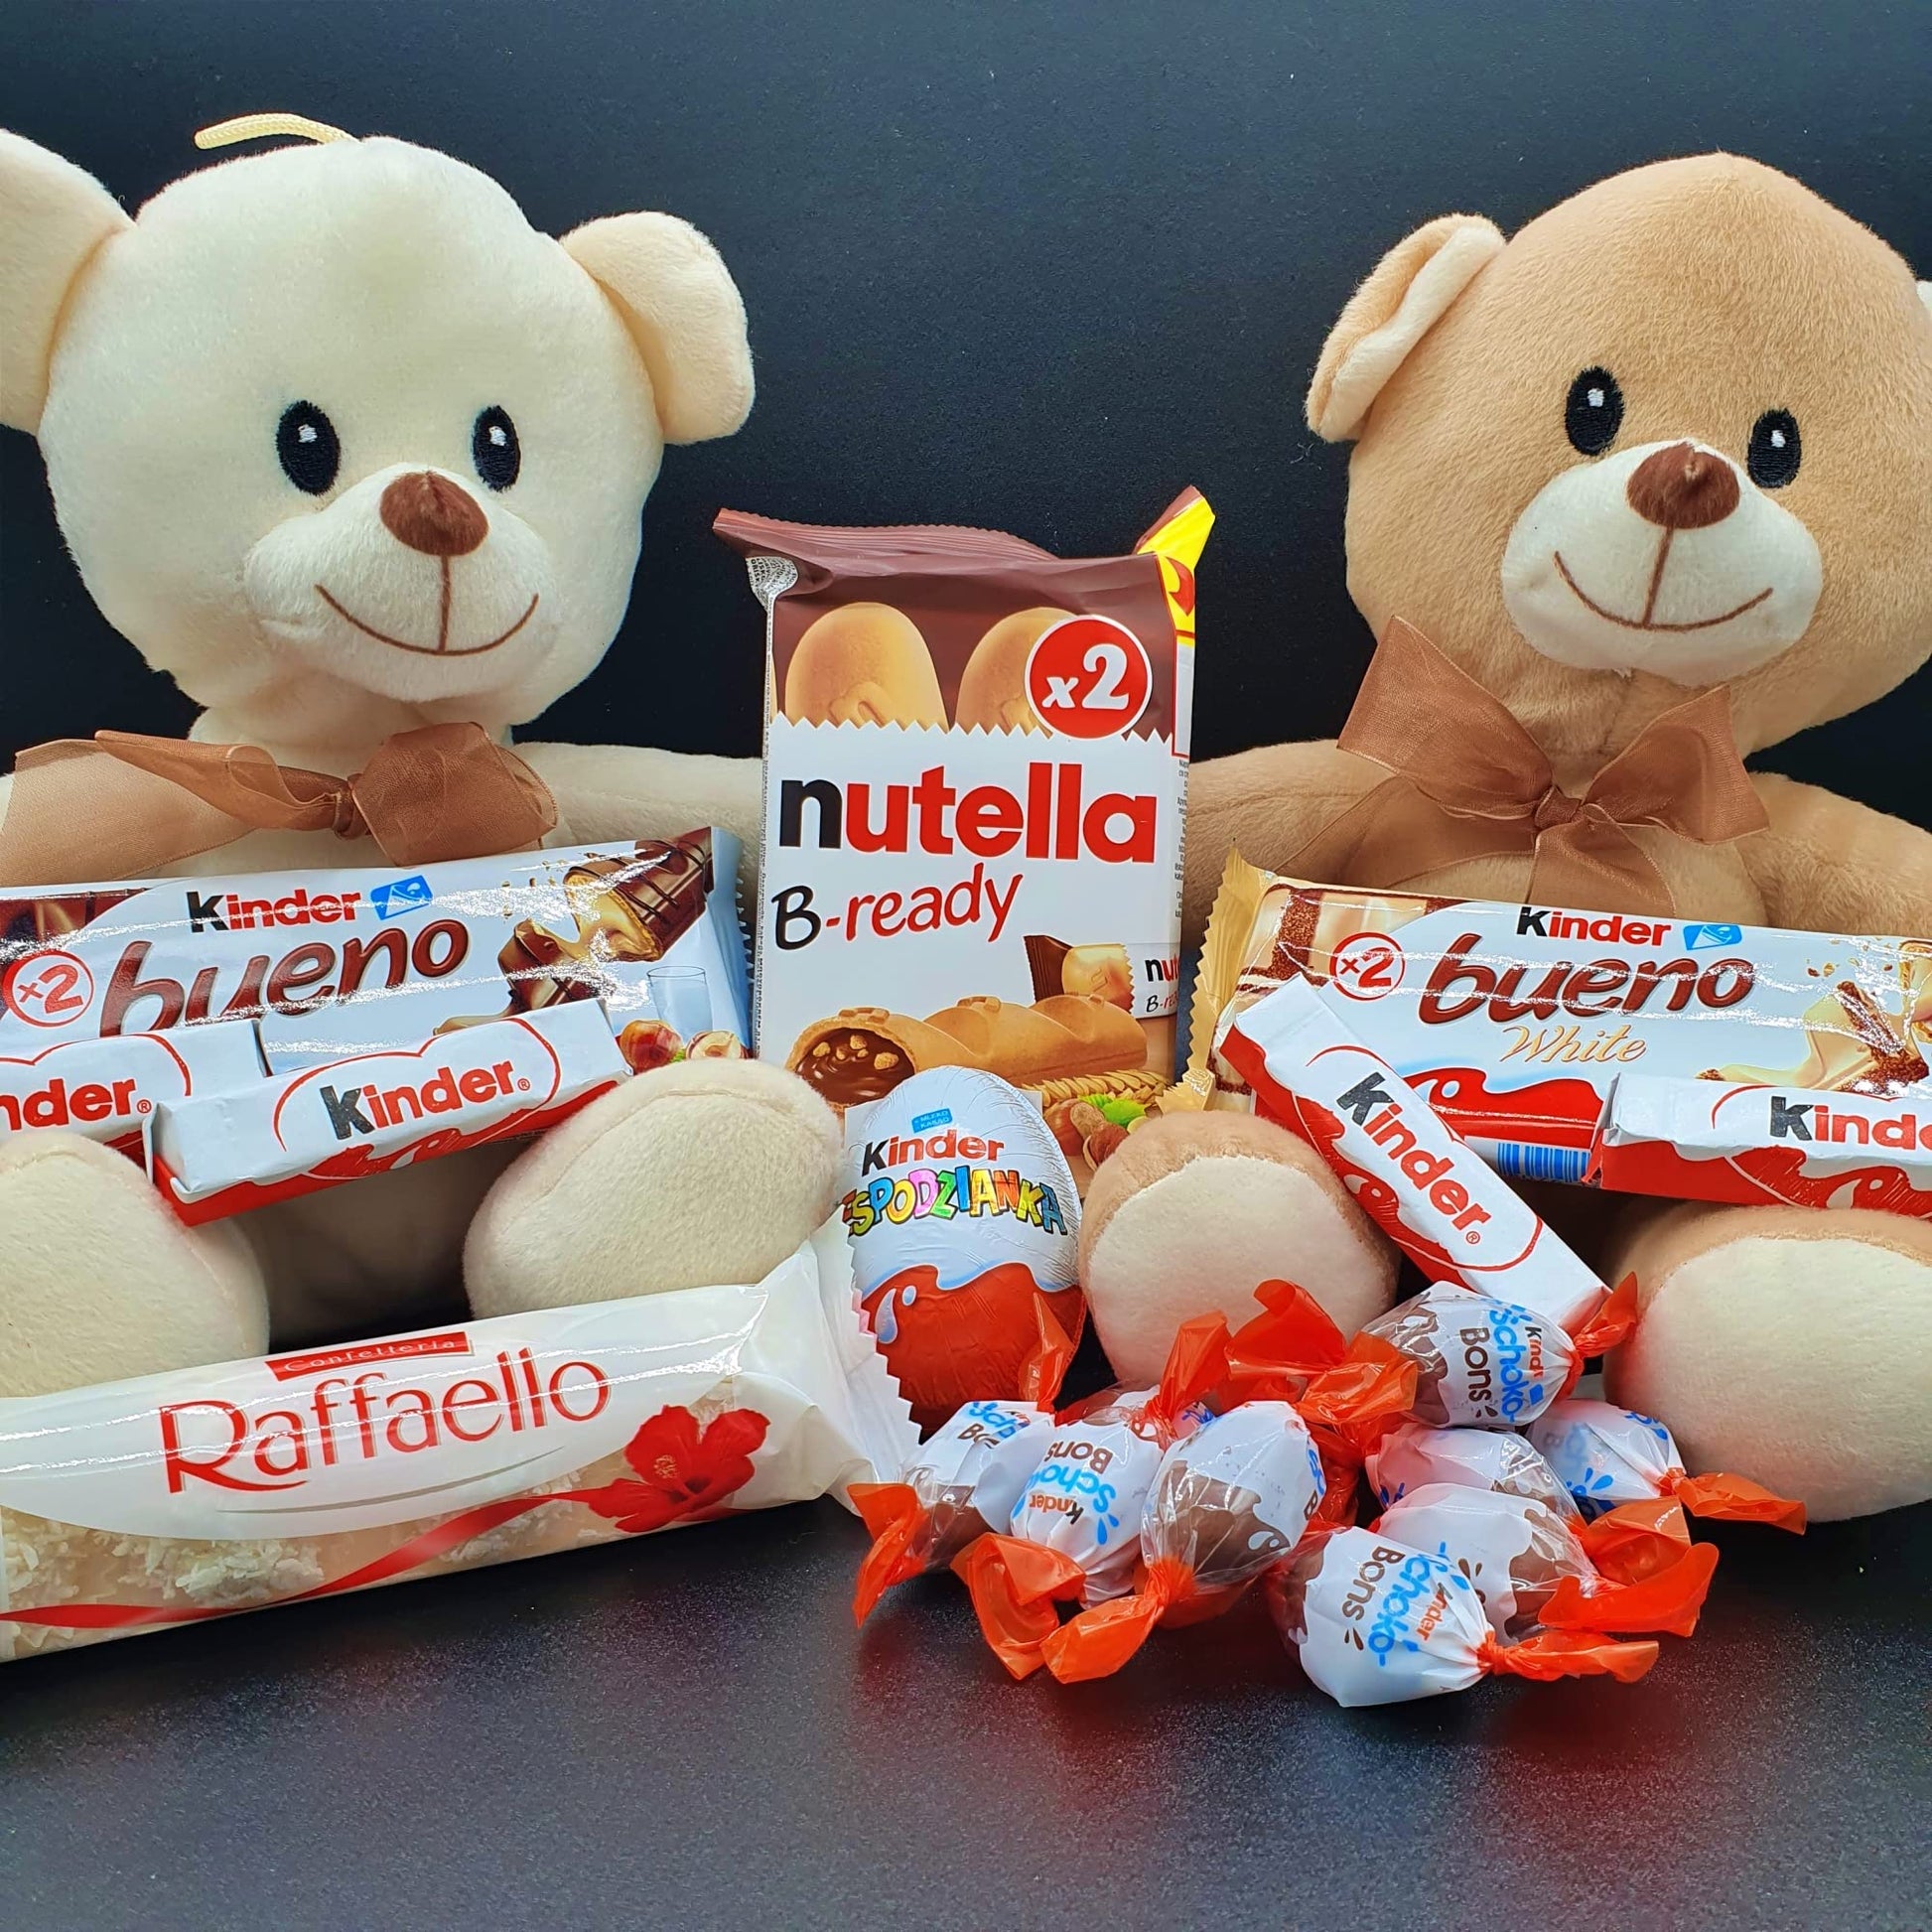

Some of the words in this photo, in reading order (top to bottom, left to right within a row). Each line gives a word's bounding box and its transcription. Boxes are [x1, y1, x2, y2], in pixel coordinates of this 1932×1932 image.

[1041, 643, 1130, 711] x2
[778, 761, 1158, 864] nutella
[186, 889, 361, 933] Kinder
[770, 862, 1024, 950] B-ready
[1516, 906, 1672, 946] Kinder
[16, 963, 84, 1015] x2
[99, 919, 469, 1037] bueno
[1338, 945, 1394, 988] x2
[1418, 933, 1756, 1025] bueno
[1499, 1025, 1647, 1062] White
[862, 1129, 1005, 1176] Kinder
[842, 1166, 1068, 1237] ESPODZIANKA
[1459, 1327, 1492, 1402] Bons
[159, 1347, 611, 1493] Raffaello
[1043, 1441, 1114, 1474] Bons
[1342, 1546, 1406, 1620] Bons
